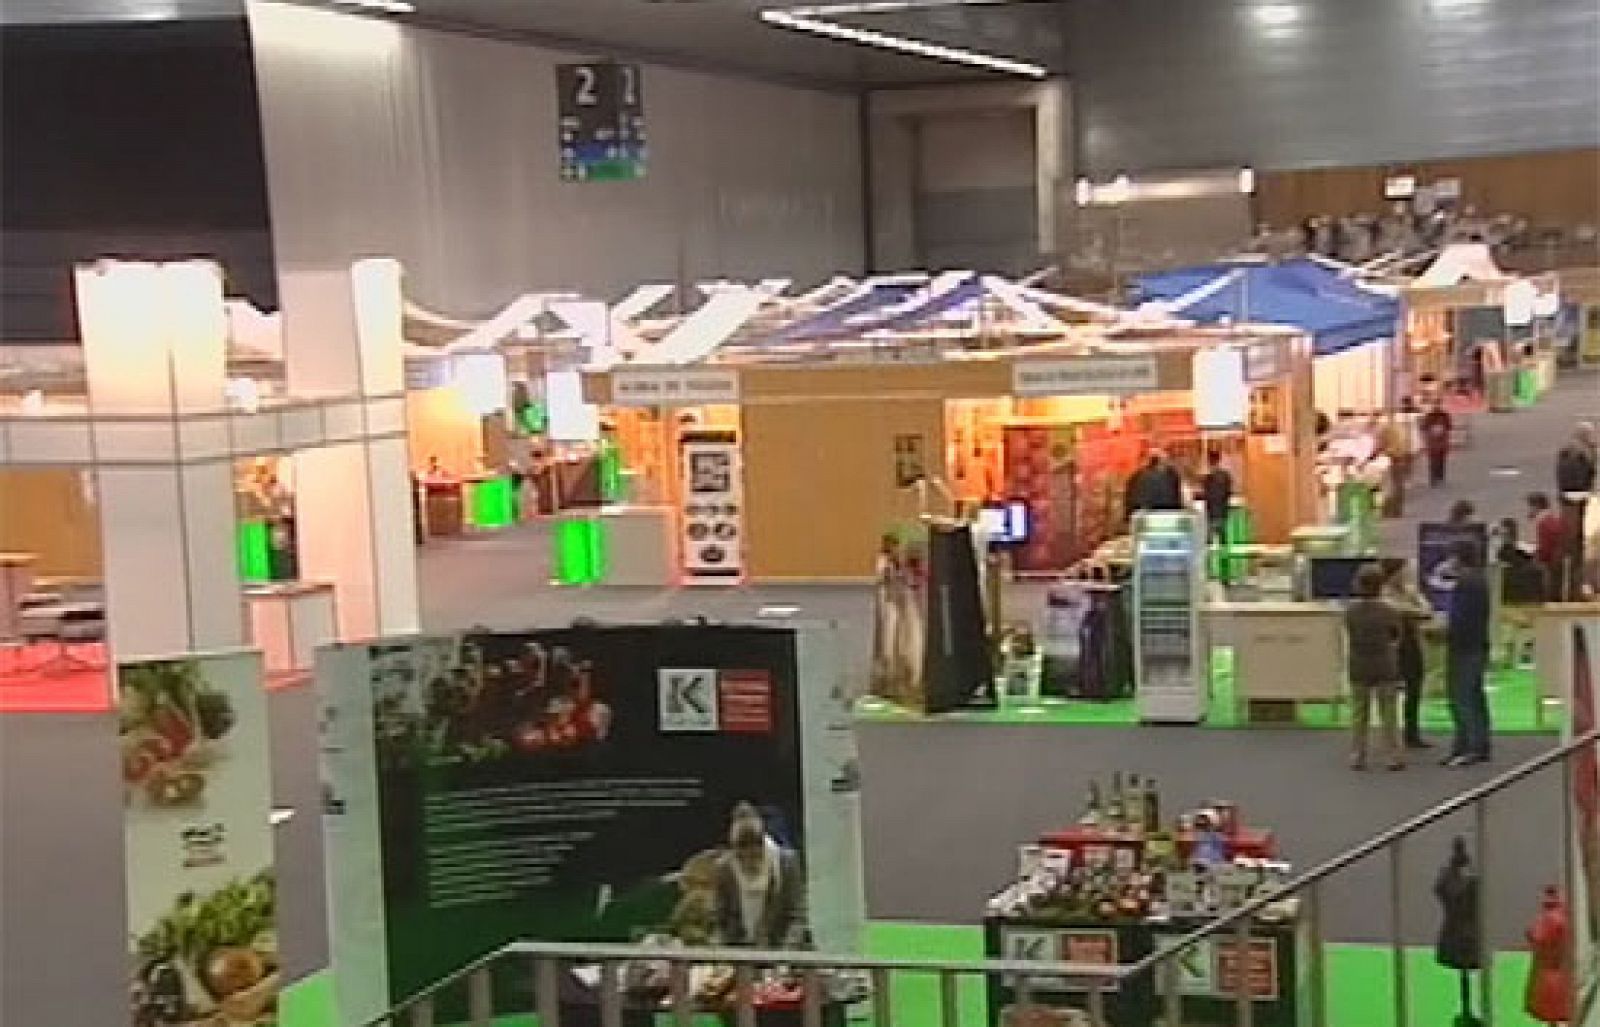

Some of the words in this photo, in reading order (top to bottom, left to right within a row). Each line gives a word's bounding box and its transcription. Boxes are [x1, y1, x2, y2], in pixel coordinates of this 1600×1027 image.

[575, 67, 597, 105] 2
[622, 67, 636, 105] 1
[667, 674, 706, 714] K
